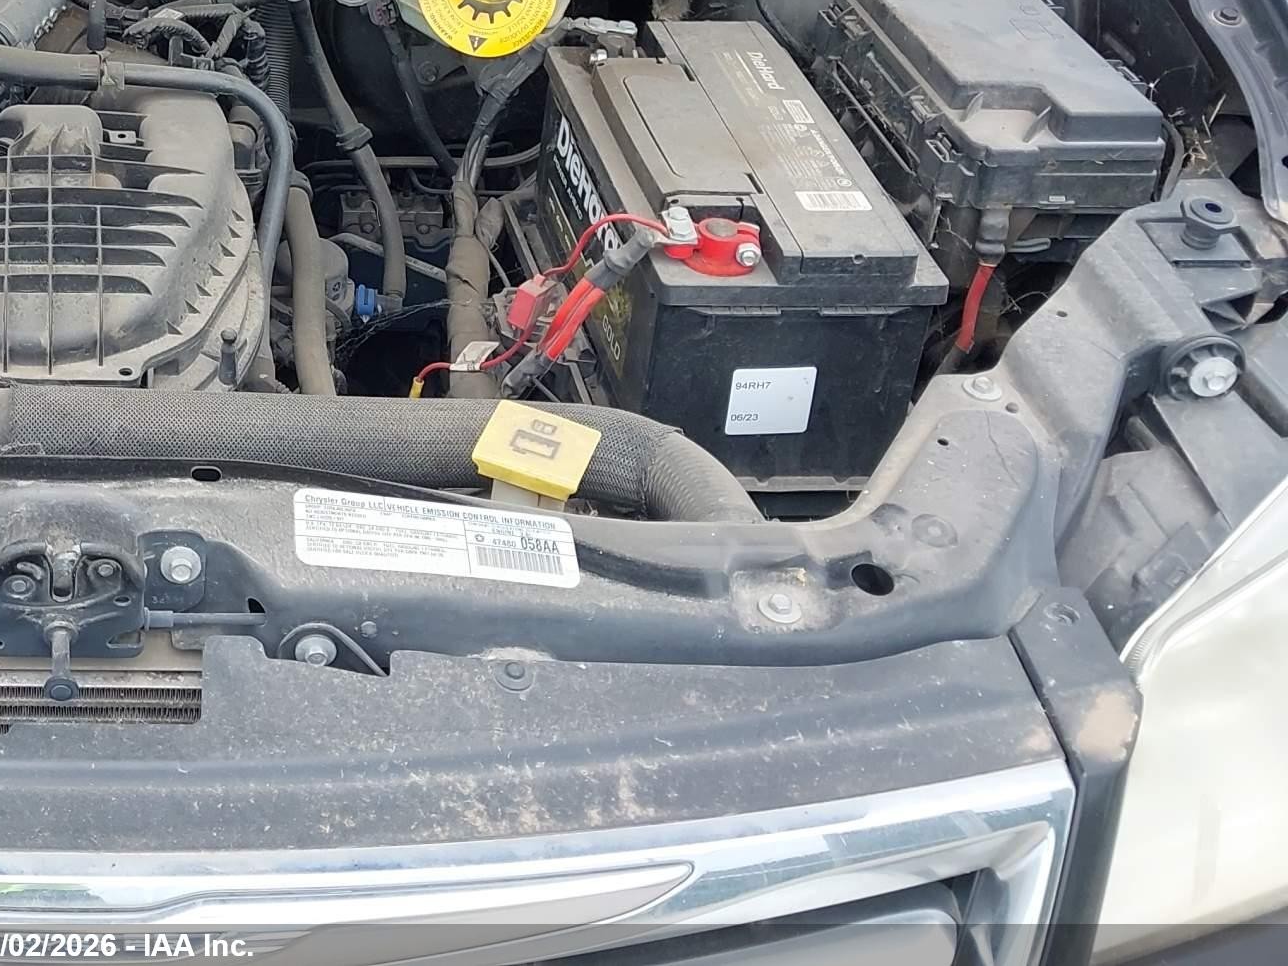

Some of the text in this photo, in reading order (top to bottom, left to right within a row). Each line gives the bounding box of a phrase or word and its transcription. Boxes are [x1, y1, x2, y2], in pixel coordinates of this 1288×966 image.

[746, 50, 786, 90] DieHard
[602, 314, 621, 360] GOLD
[735, 381, 772, 390] 94RH7
[730, 414, 759, 422] 06/23
[305, 495, 338, 505] Chrysler
[342, 498, 365, 508] Group
[368, 500, 383, 508] LLC
[386, 504, 419, 513] VEHICLE
[422, 507, 460, 518] EMISSION
[463, 512, 498, 523] CONTROL
[501, 516, 555, 529] INFORMATION
[520, 537, 560, 553] 058AA
